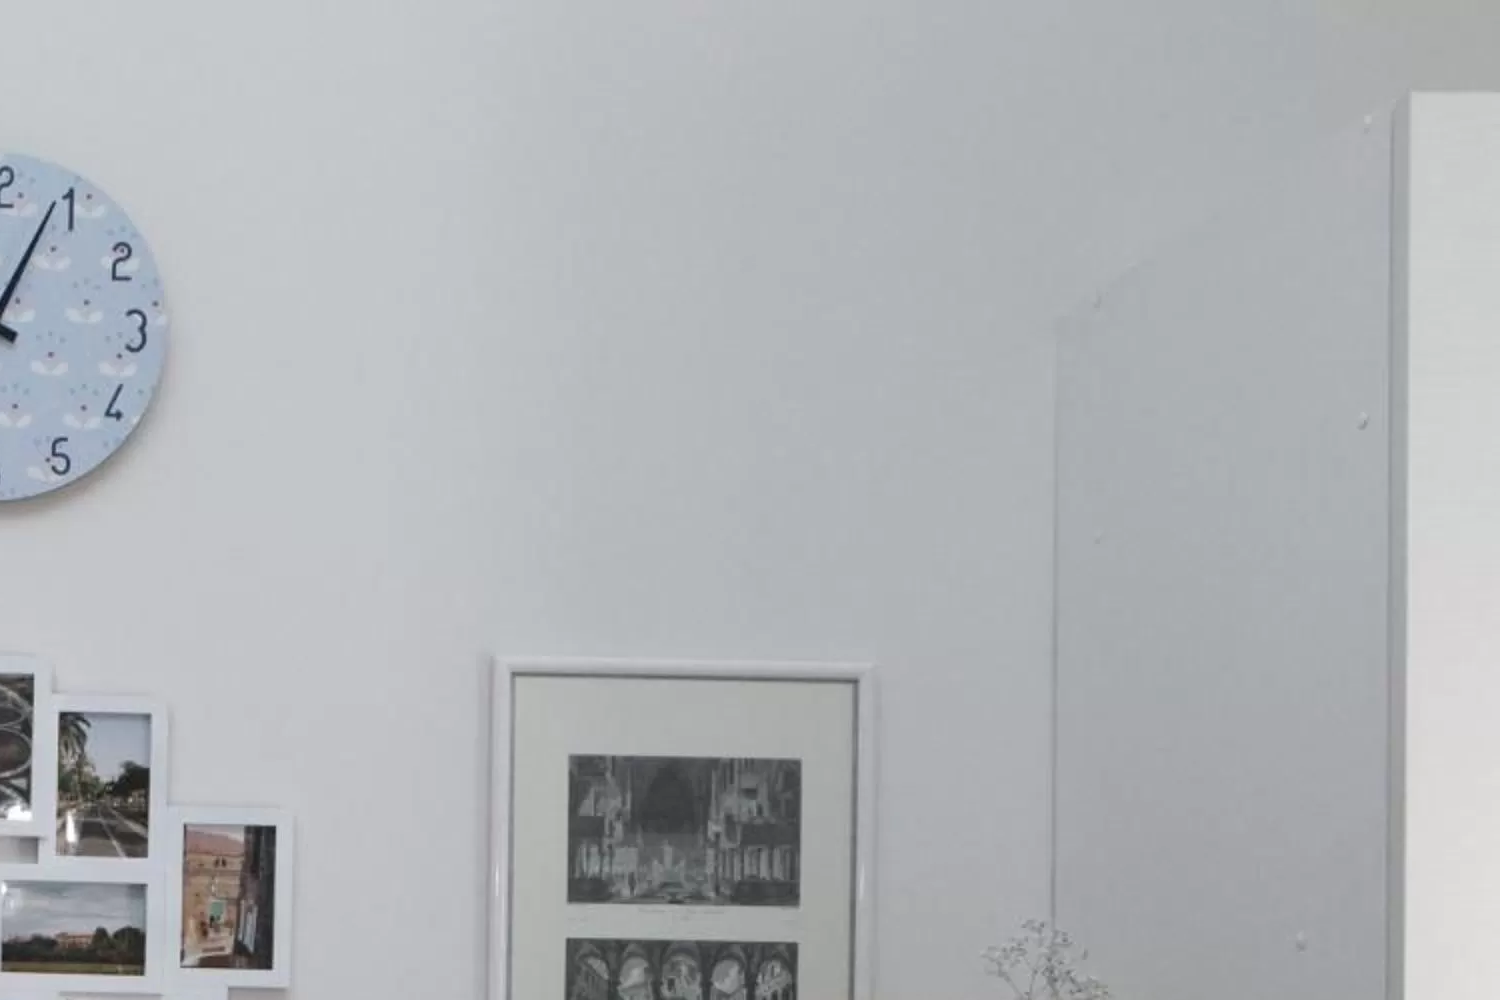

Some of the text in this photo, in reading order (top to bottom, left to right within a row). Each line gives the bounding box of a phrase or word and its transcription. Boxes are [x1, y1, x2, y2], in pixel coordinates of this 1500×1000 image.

[62, 187, 75, 231] 1
[111, 241, 133, 281] 2
[124, 309, 147, 352] 3
[104, 383, 124, 421] 4
[51, 437, 71, 475] 5
